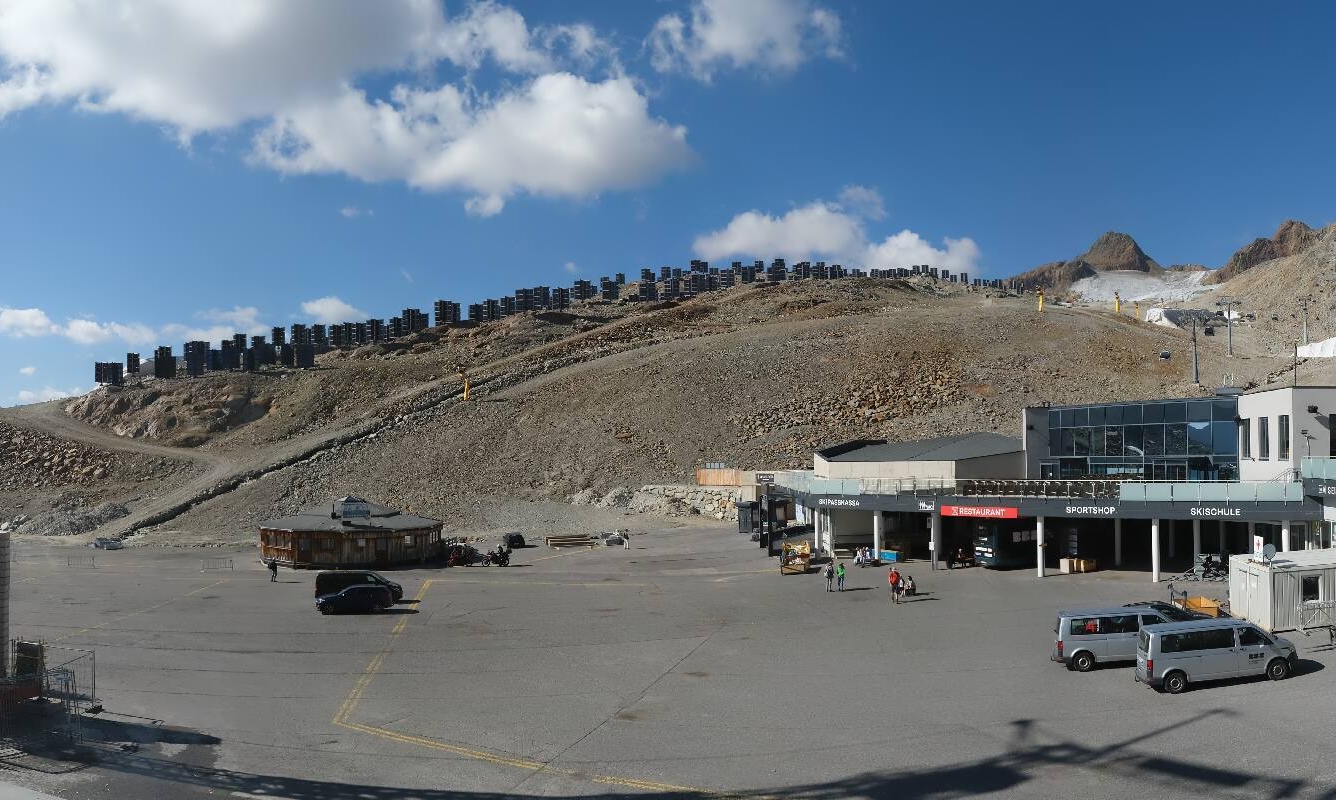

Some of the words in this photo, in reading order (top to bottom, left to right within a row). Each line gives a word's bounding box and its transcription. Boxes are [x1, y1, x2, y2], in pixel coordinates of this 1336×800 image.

[818, 498, 860, 507] SKIPASSKASSA
[959, 507, 1005, 517] RESTAURANT
[1065, 506, 1116, 515] SPORTSHOP
[1190, 507, 1241, 516] SKISCHULE
